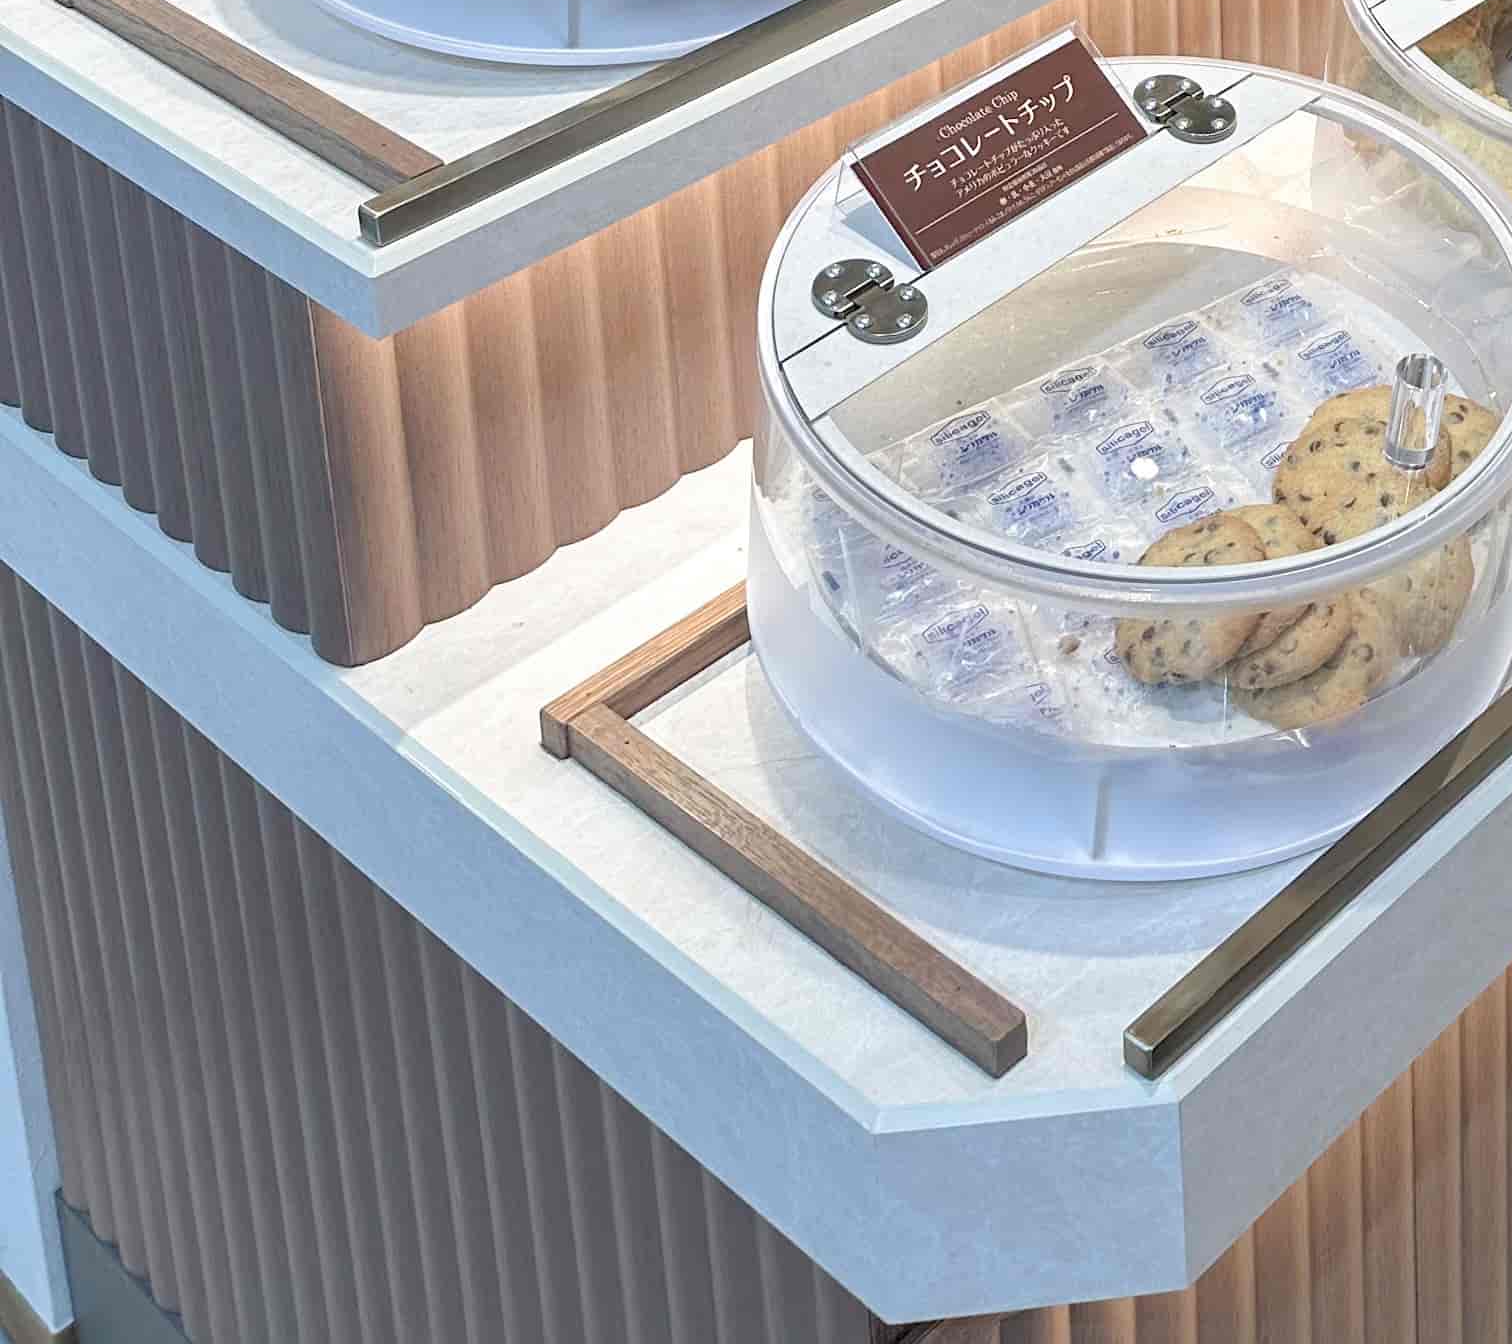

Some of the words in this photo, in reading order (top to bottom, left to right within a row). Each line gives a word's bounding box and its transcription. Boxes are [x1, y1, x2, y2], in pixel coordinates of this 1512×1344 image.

[938, 102, 992, 139] Chocolate
[992, 88, 1019, 112] Chip
[904, 75, 1075, 191] チョコレートチップ
[1100, 423, 1152, 453] silicagel
[991, 474, 1045, 504] silicagel
[1161, 489, 1213, 520] silicagel
